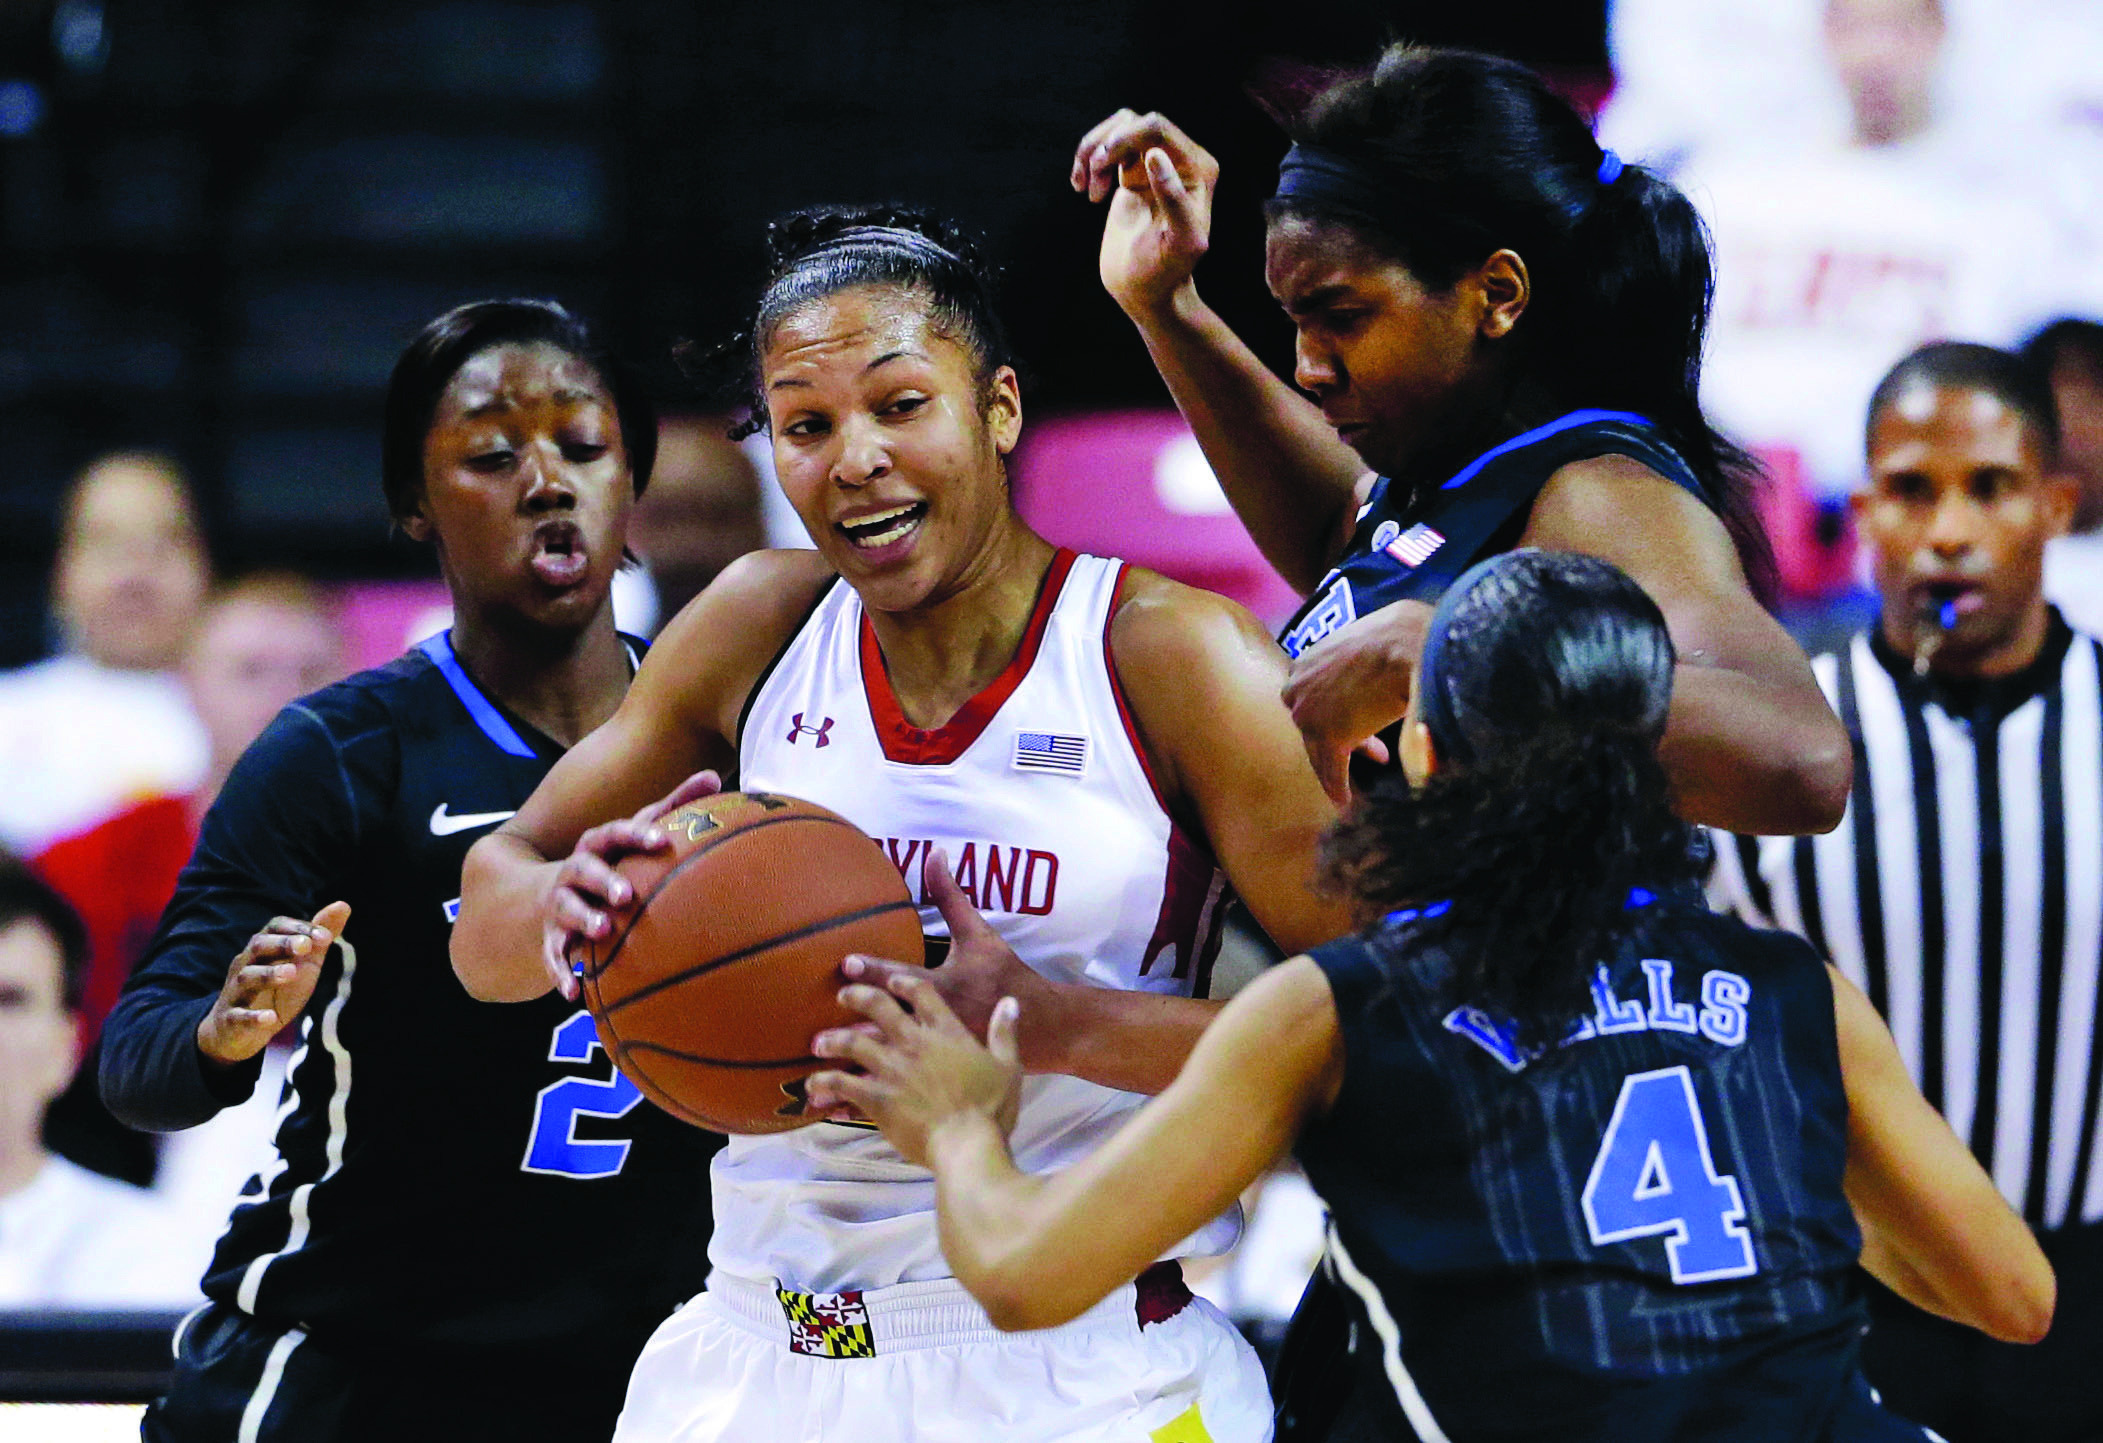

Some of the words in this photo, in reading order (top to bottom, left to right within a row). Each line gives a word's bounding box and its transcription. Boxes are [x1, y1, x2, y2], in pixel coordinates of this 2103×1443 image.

[870, 838, 1059, 916] YLAND
[521, 1009, 645, 1179] 2
[1581, 1065, 1758, 1285] 4
